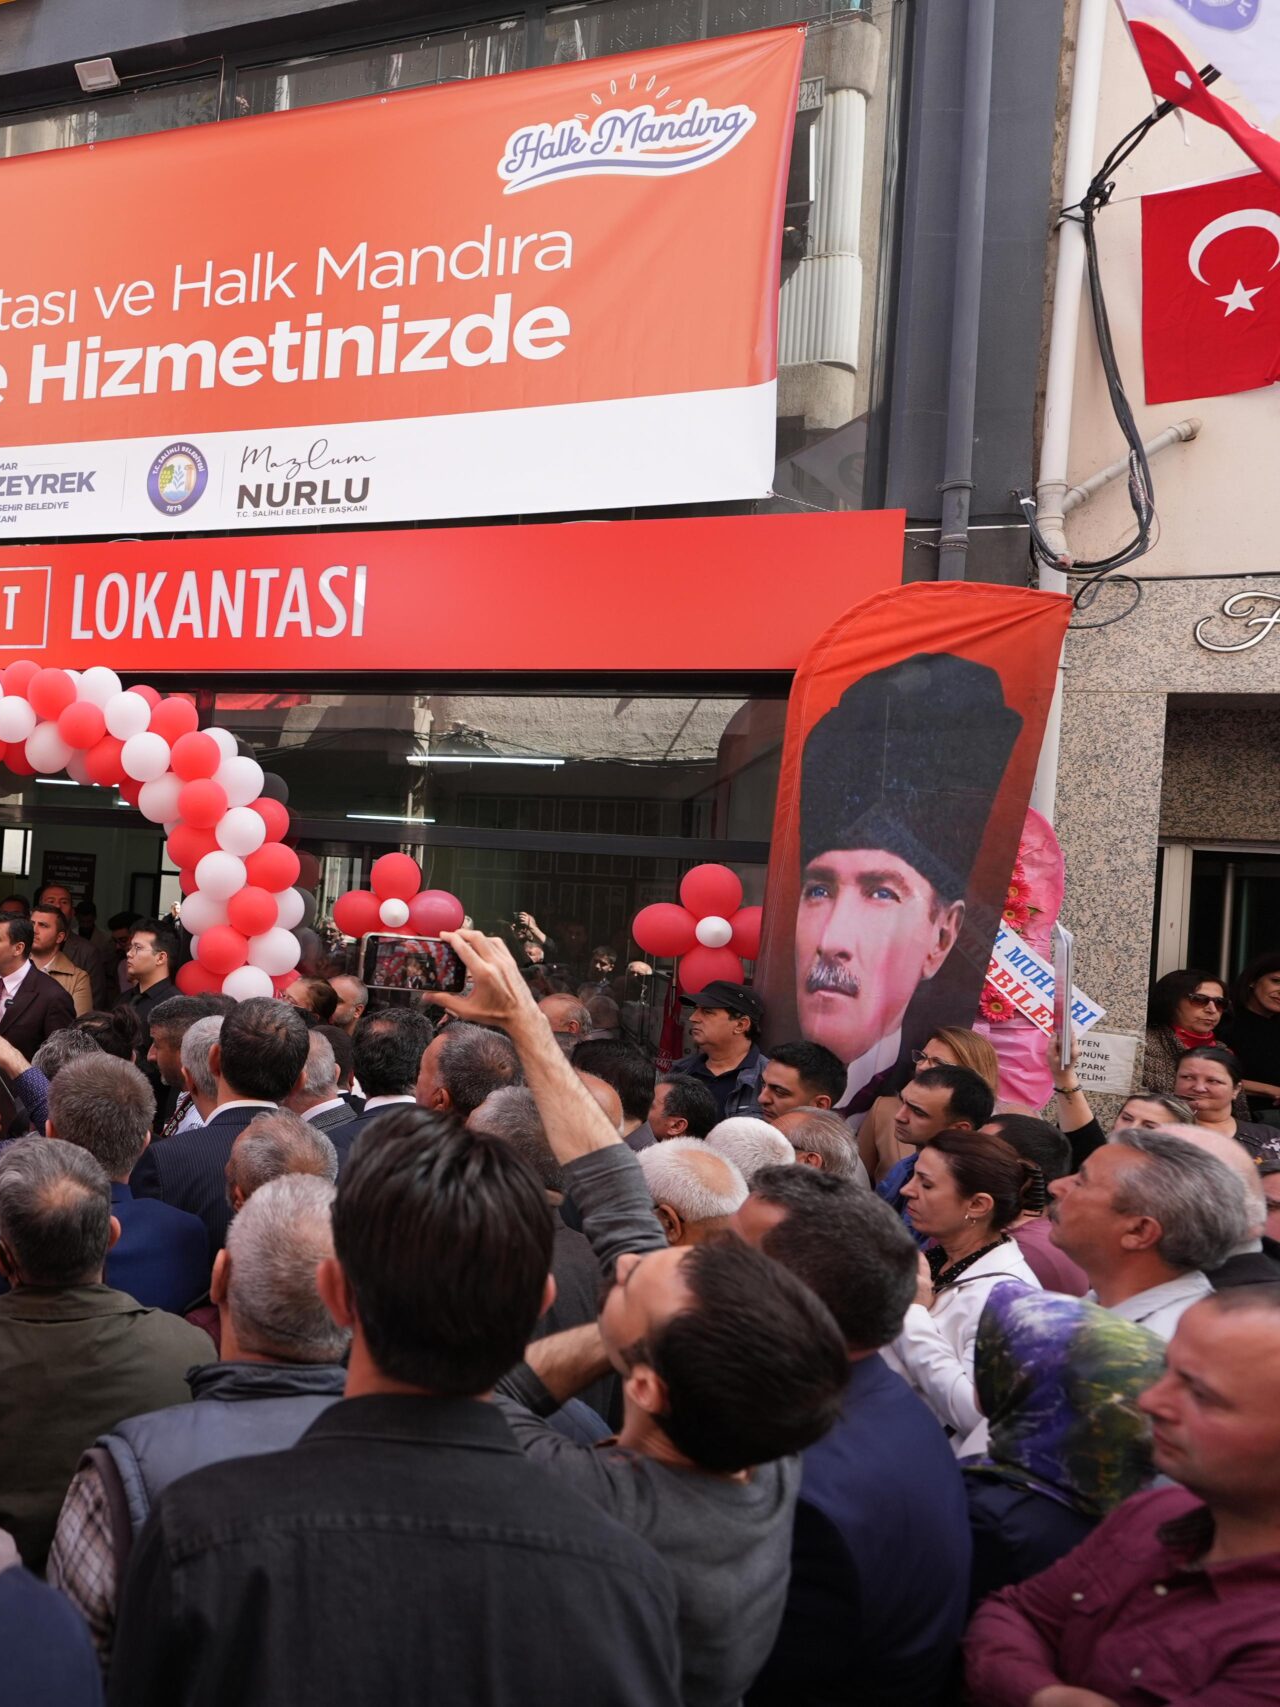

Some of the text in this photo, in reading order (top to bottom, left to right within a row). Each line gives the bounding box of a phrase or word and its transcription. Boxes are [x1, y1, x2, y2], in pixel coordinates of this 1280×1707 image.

[505, 106, 747, 173] Halk Mandıra
[93, 279, 155, 319] ve
[172, 251, 298, 311] Halk
[315, 224, 574, 296] Mandıra
[28, 292, 571, 405] Hizmetinizde
[240, 438, 376, 480] Mazlum
[24, 501, 69, 512] BELEDİYE
[236, 477, 370, 510] NURLU
[252, 508, 284, 517] SALİHLİ
[285, 506, 327, 516] BELEDİYE
[329, 504, 368, 514] BAŞKANI
[70, 565, 368, 640] LOKANTASI
[1004, 945, 1098, 1026] MUHTRI
[1077, 1039, 1100, 1048] TFEN
[1075, 1072, 1106, 1081] YELİM!
[1081, 1062, 1106, 1071] PARK
